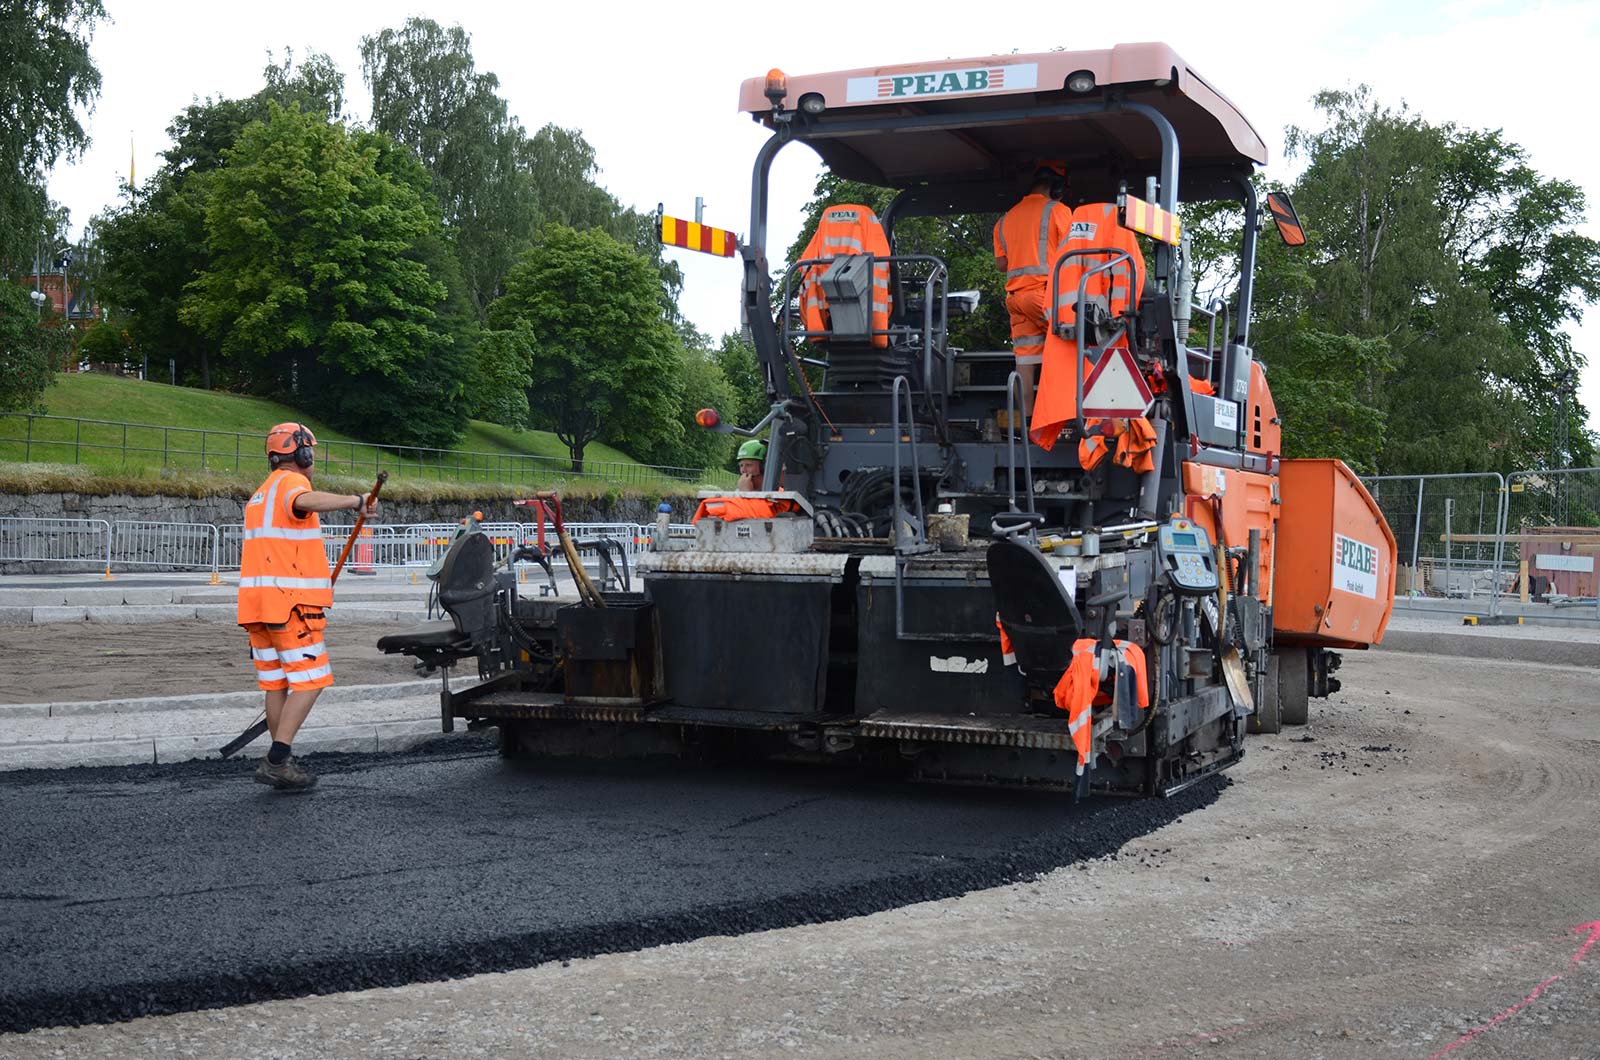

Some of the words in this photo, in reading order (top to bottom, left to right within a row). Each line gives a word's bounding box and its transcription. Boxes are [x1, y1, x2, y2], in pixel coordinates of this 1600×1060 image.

[891, 70, 988, 96] PEAB
[1218, 403, 1234, 418] PEAB
[1341, 538, 1372, 574] PEAB
